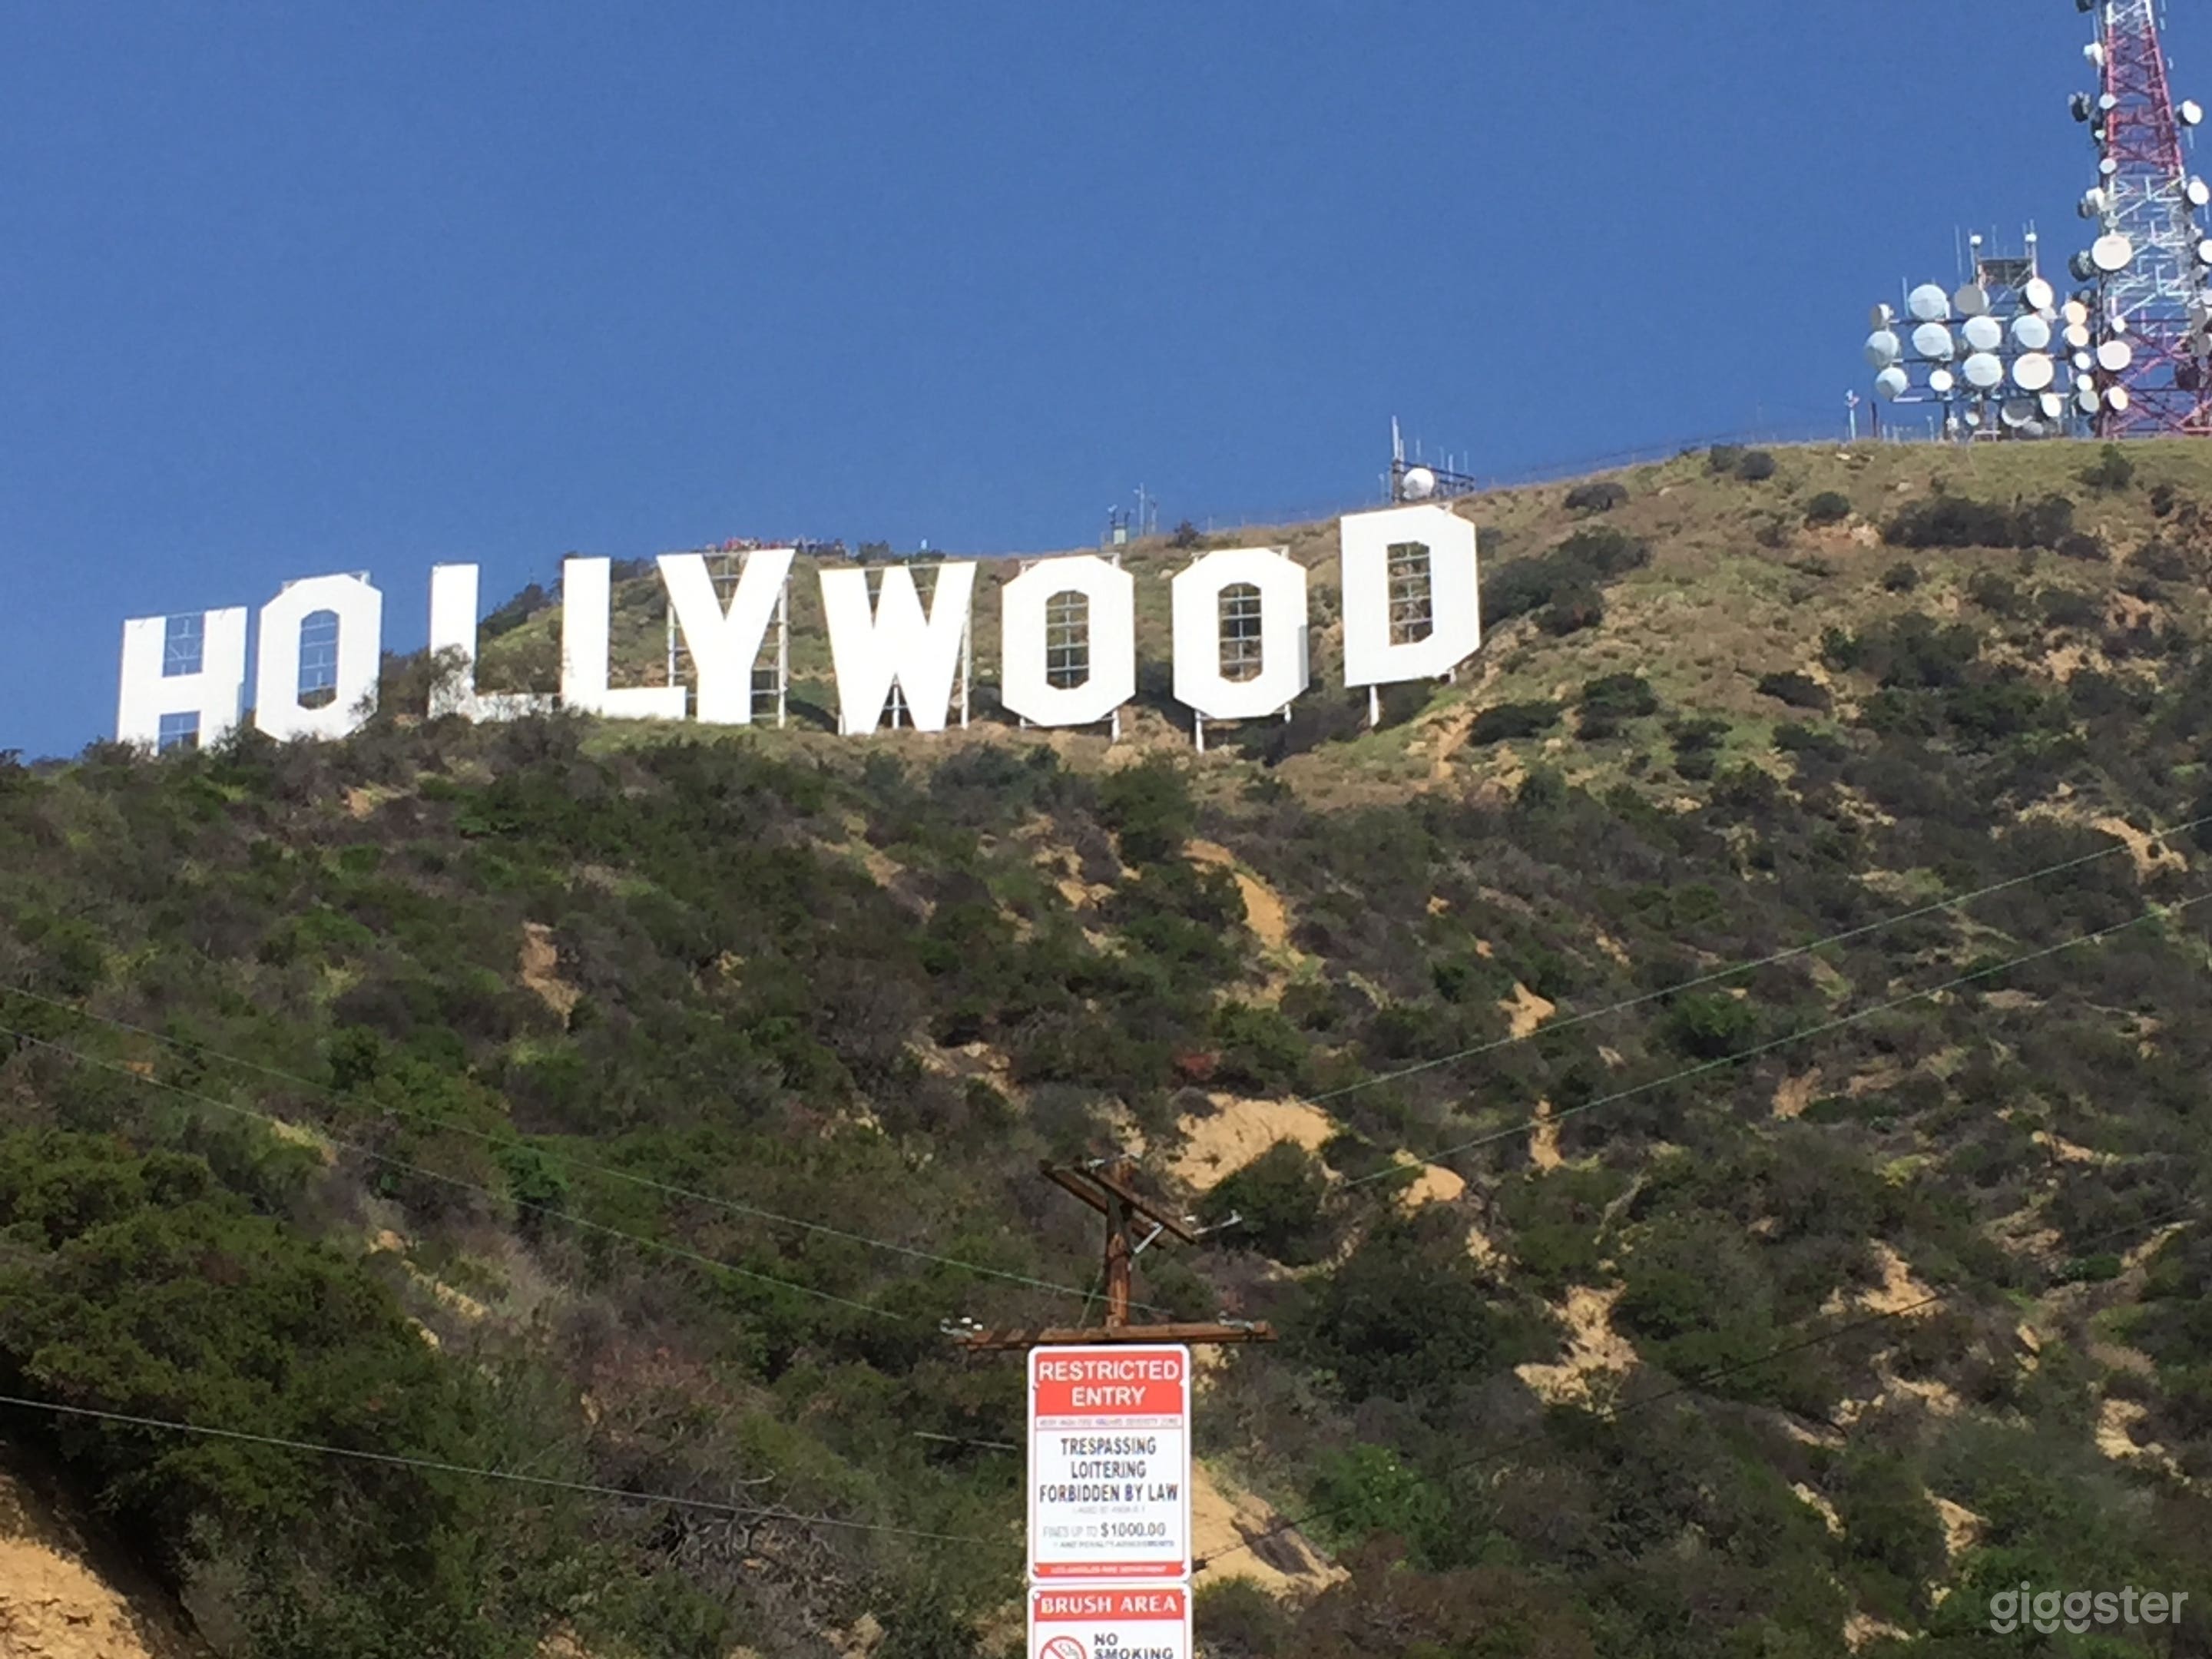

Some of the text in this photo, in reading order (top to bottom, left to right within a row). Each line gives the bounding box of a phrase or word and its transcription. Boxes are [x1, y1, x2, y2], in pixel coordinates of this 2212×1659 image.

[117, 503, 1481, 757] HOLLYWOOD
[1039, 1360, 1180, 1382] RESTRICTED
[1071, 1386, 1147, 1406] ENTRY
[1061, 1436, 1157, 1455] TRESPASSING
[1071, 1460, 1147, 1479] LOITERING
[1039, 1482, 1179, 1502] FORBIDDEN BY LAW
[1101, 1522, 1166, 1538] $1000.00
[1041, 1594, 1177, 1614] BRUSH AREA
[1094, 1633, 1118, 1646] NO
[1094, 1647, 1174, 1659] SMOKING
